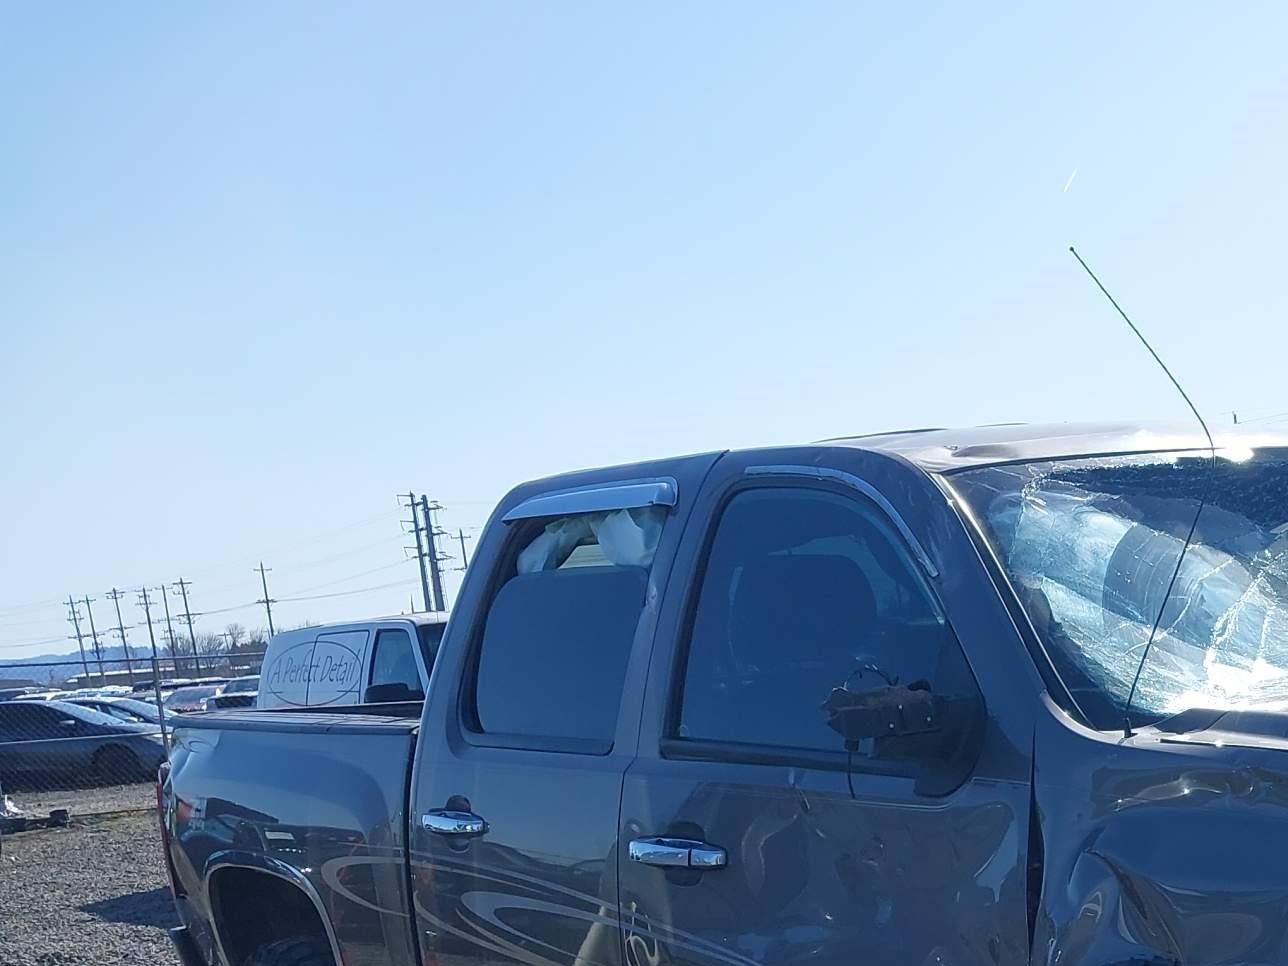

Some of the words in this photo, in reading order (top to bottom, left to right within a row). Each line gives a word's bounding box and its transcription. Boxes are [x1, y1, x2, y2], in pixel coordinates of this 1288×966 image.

[271, 658, 282, 684] A
[282, 649, 321, 684] Perfect
[320, 649, 360, 685] Detail
